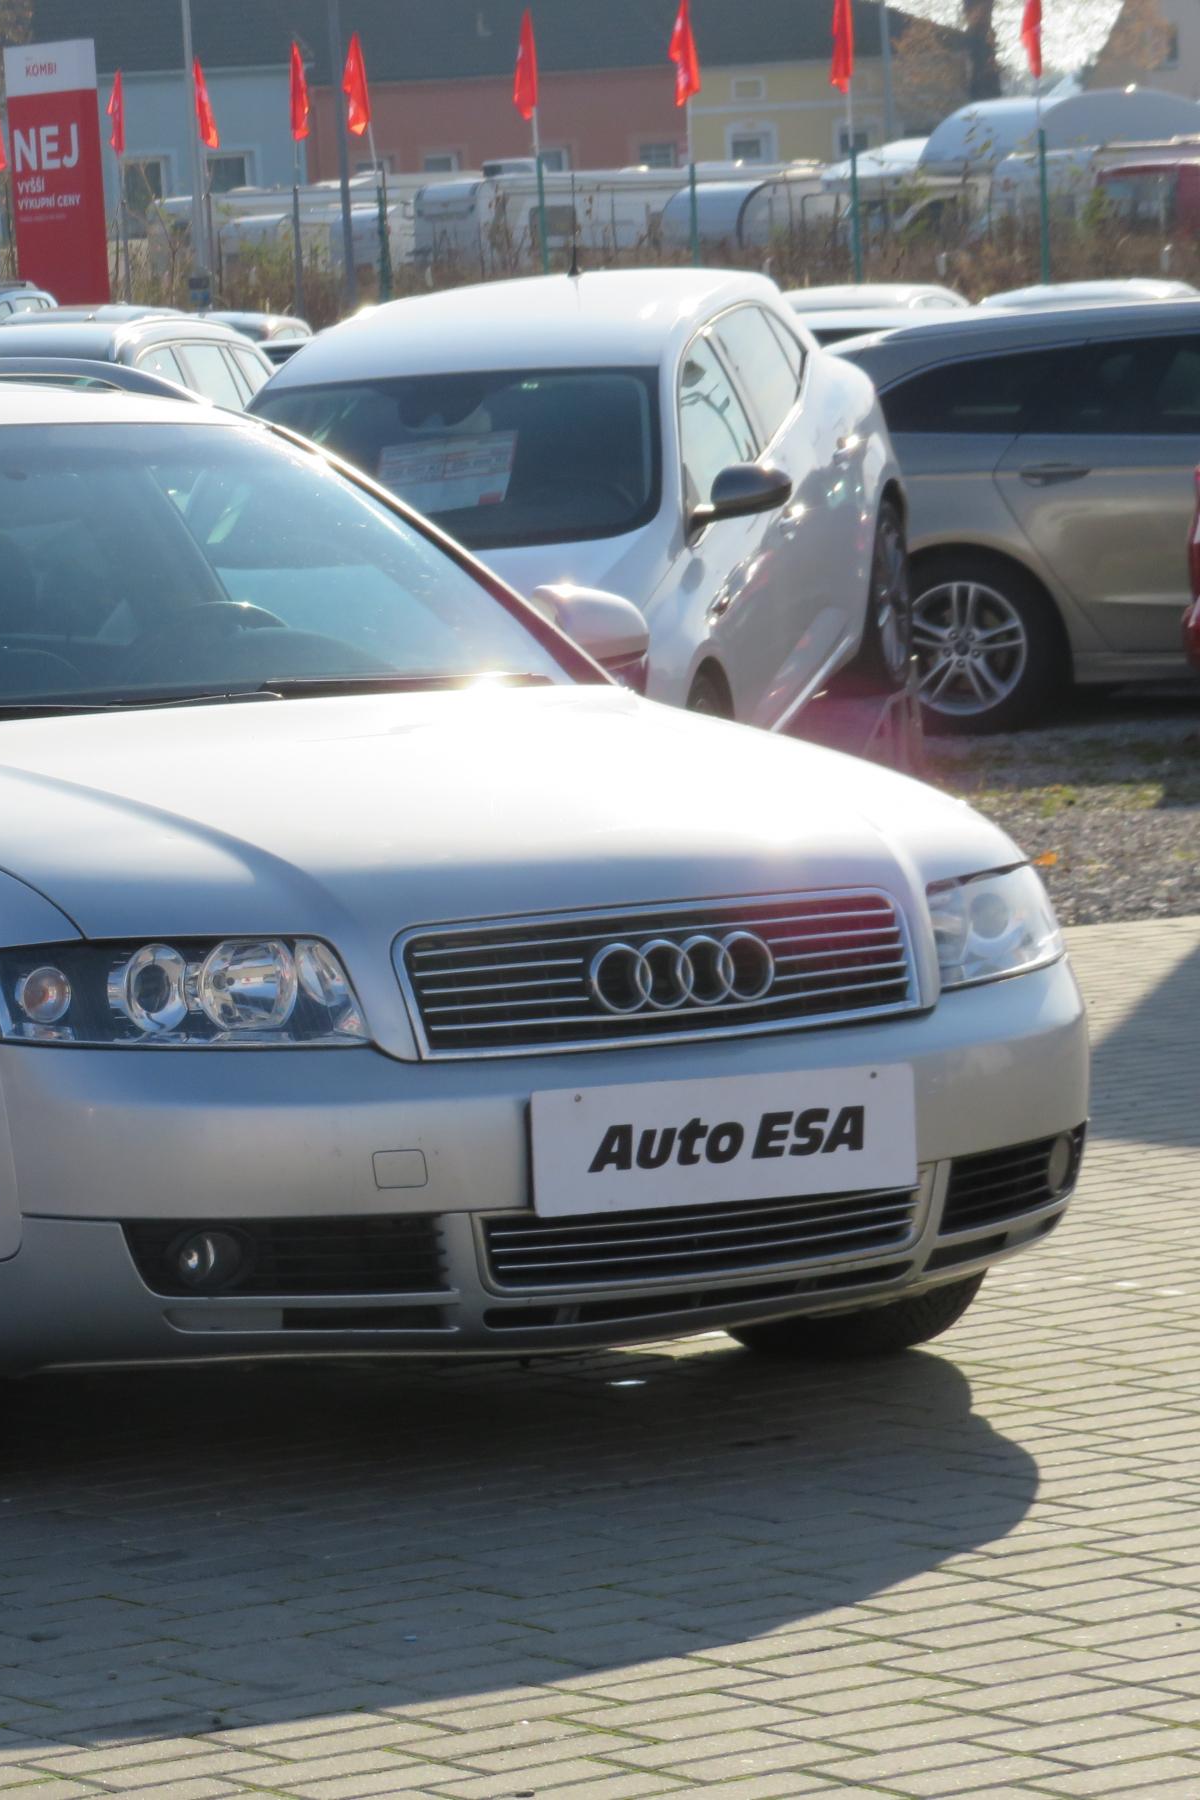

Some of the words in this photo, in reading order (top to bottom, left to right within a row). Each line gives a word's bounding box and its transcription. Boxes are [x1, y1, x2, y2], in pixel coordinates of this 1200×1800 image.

[25, 62, 57, 77] KOMBI
[13, 123, 80, 172] NEJ
[57, 193, 81, 207] CENY
[587, 1118, 745, 1173] Auto
[751, 1105, 865, 1160] ESA
